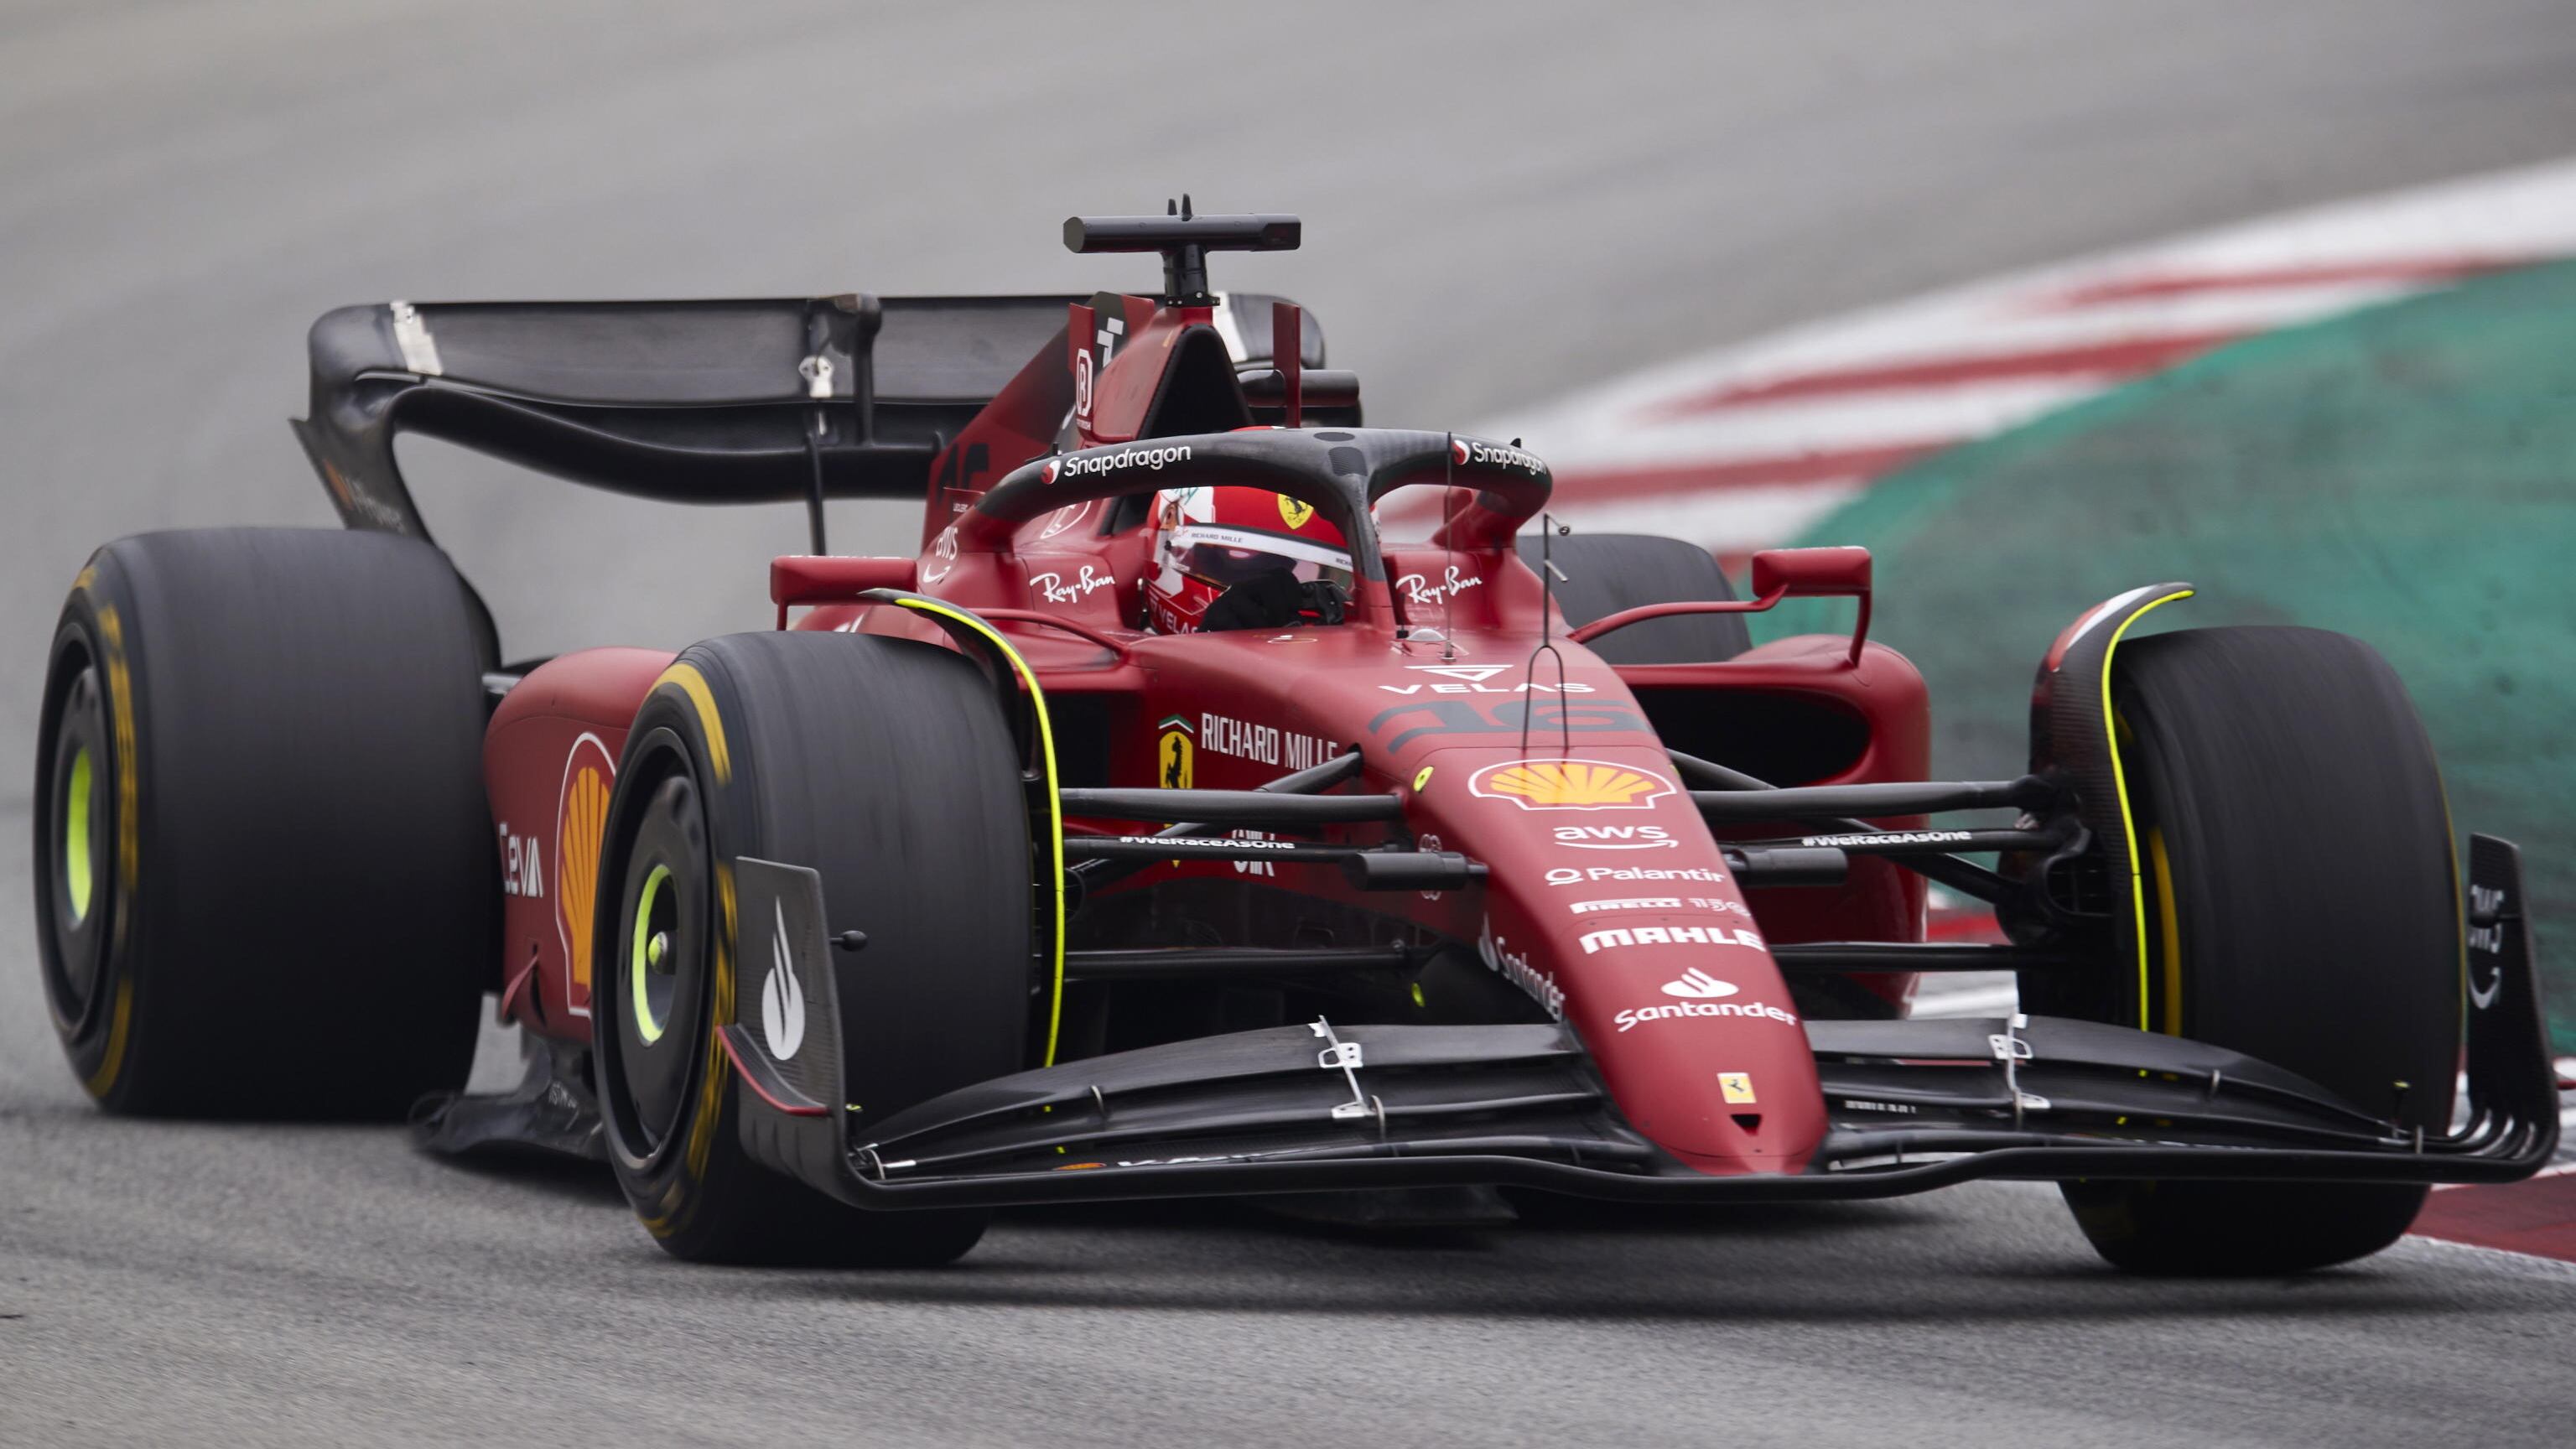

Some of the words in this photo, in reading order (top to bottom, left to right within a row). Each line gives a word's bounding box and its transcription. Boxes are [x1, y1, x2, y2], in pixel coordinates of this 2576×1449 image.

[1064, 445, 1192, 476] Snapdragon
[1472, 442, 1548, 475] Snapdragon
[1379, 683, 1595, 694] VELAS
[1201, 712, 1279, 766] RICHARD
[1553, 825, 1669, 839] aws
[1802, 830, 1972, 847] #WeRaceAsOne
[1119, 836, 1295, 849] #WeRaceAsOne
[1587, 867, 1726, 883] Palantir
[1569, 897, 1683, 915] PIRELLI
[1579, 927, 1766, 955] MAHLE
[1614, 1002, 1798, 1032] Santander
